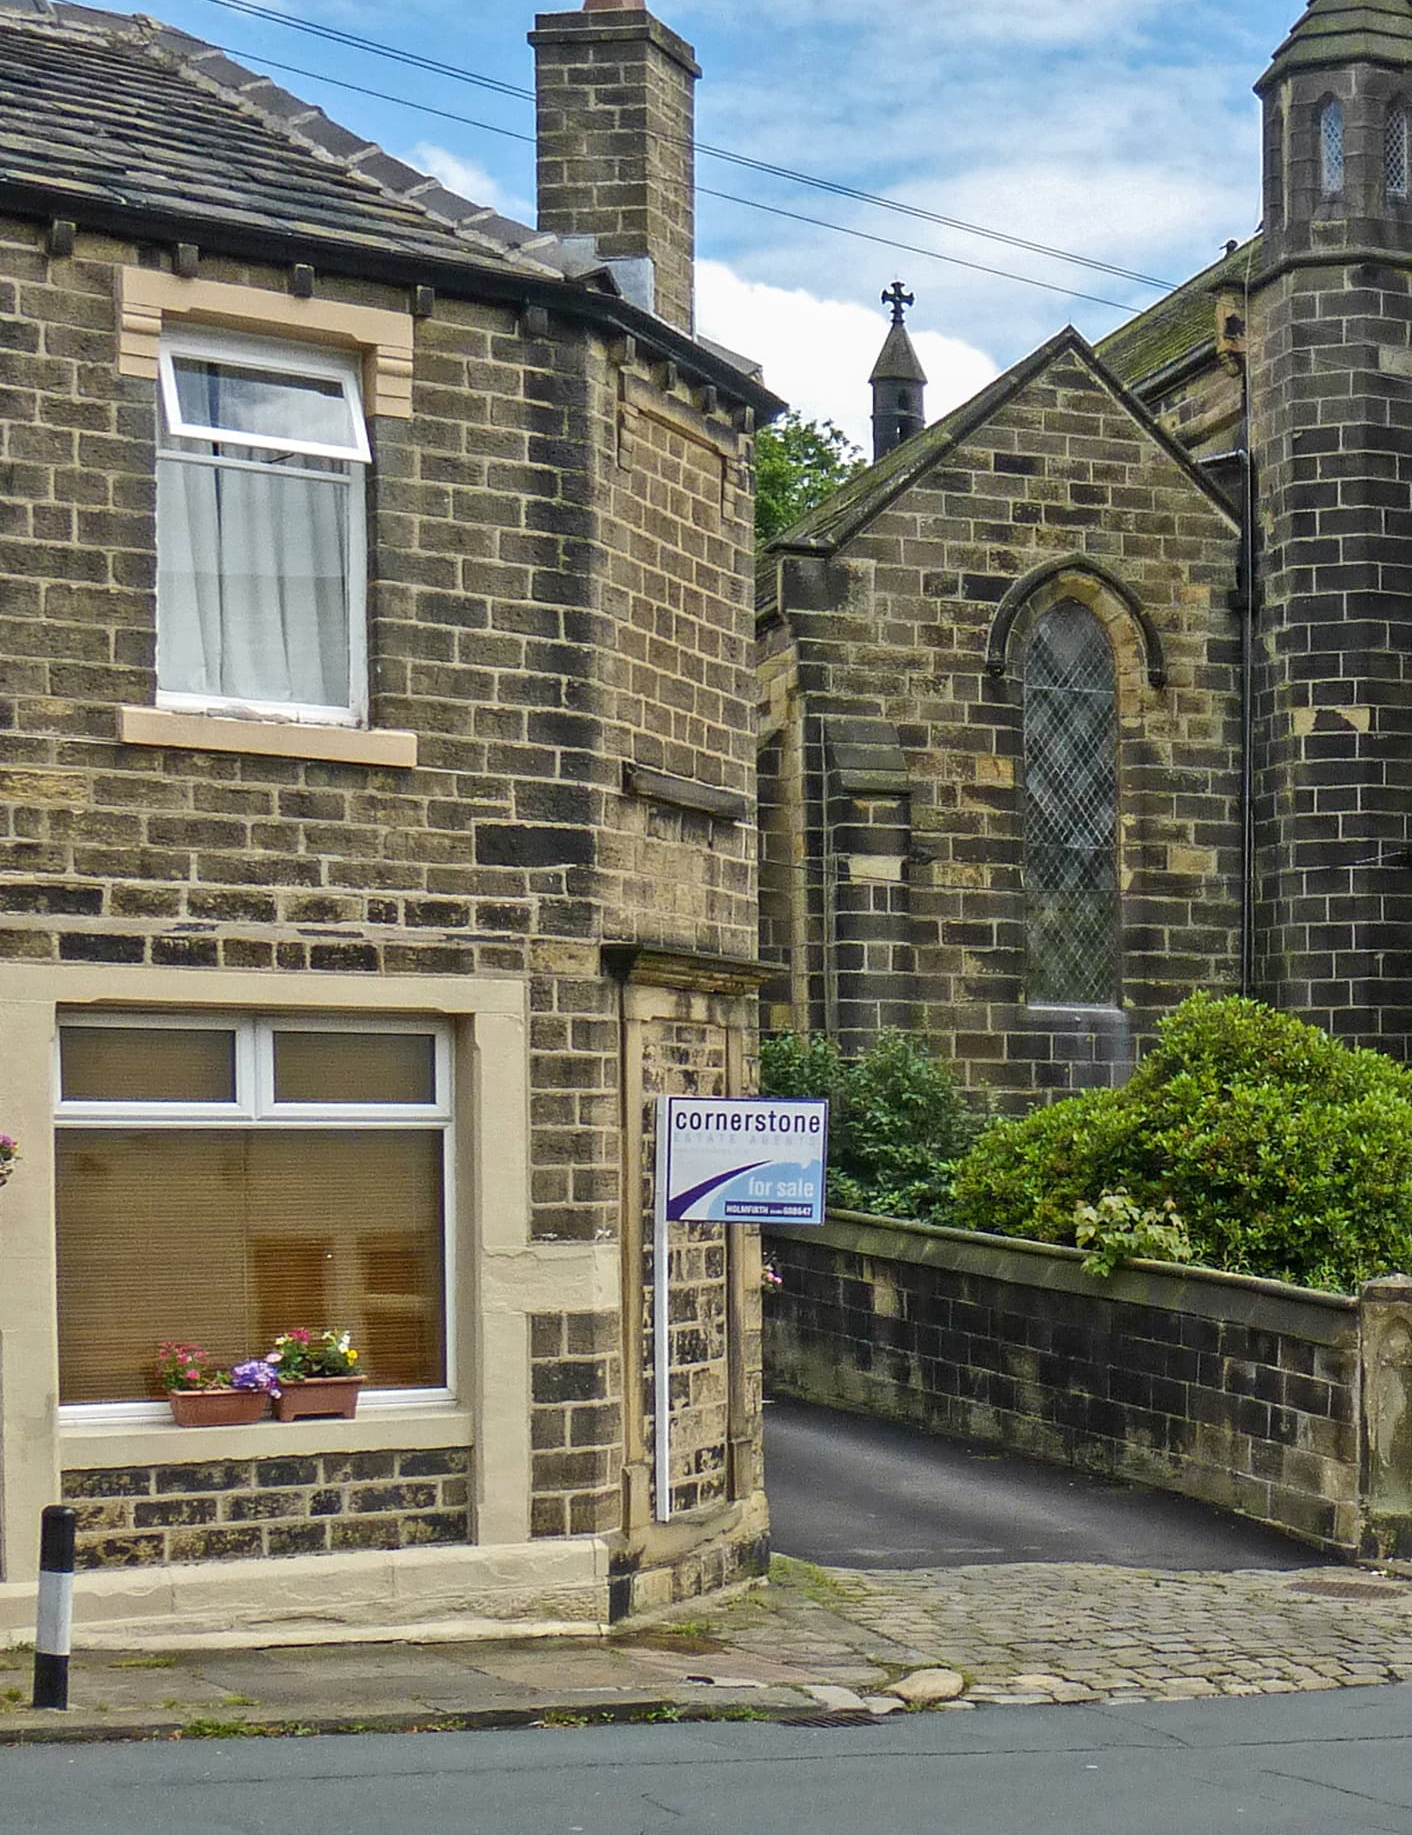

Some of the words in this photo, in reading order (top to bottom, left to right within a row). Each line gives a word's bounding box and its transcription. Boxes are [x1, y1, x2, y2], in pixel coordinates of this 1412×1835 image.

[675, 1110, 821, 1133] cornerstone
[674, 1133, 736, 1144] ESTATE
[749, 1134, 816, 1147] AGENTS
[748, 1177, 771, 1197] for
[776, 1178, 814, 1197] sale
